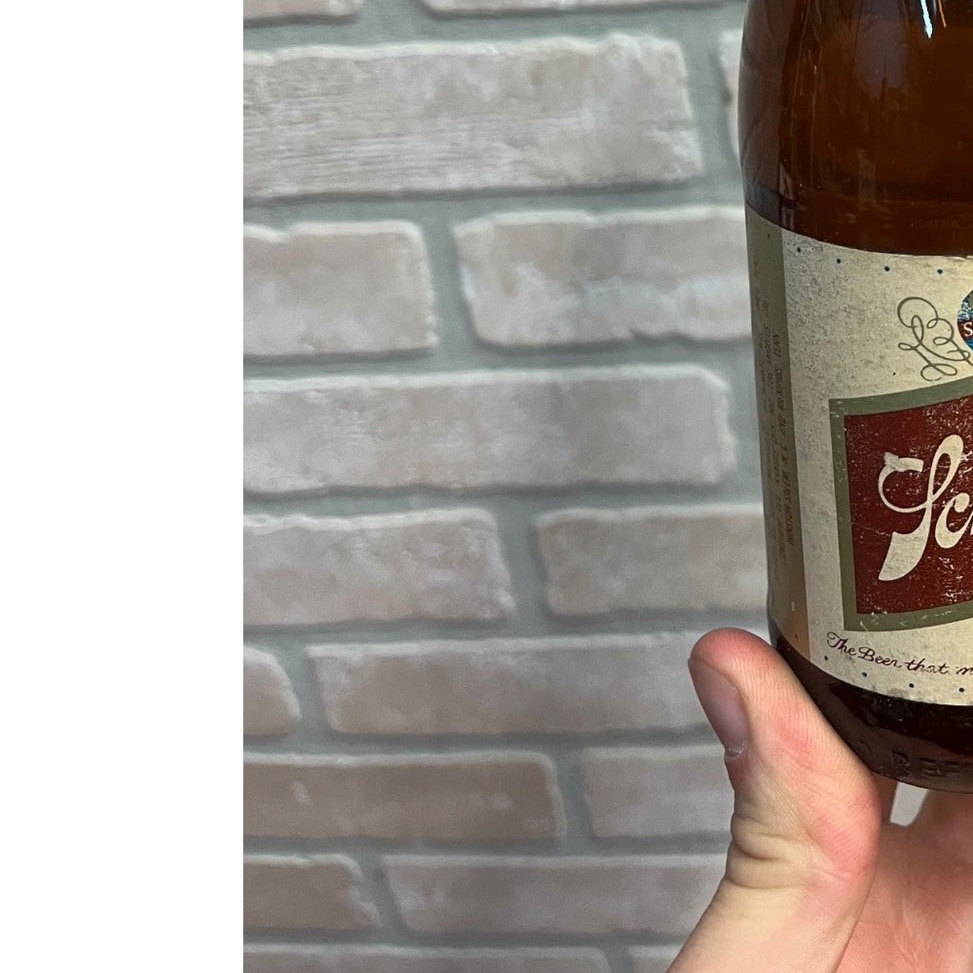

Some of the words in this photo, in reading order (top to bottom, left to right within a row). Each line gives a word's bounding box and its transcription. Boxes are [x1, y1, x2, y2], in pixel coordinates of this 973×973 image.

[826, 631, 857, 656] The
[857, 646, 902, 669] Beer
[904, 658, 949, 675] that
